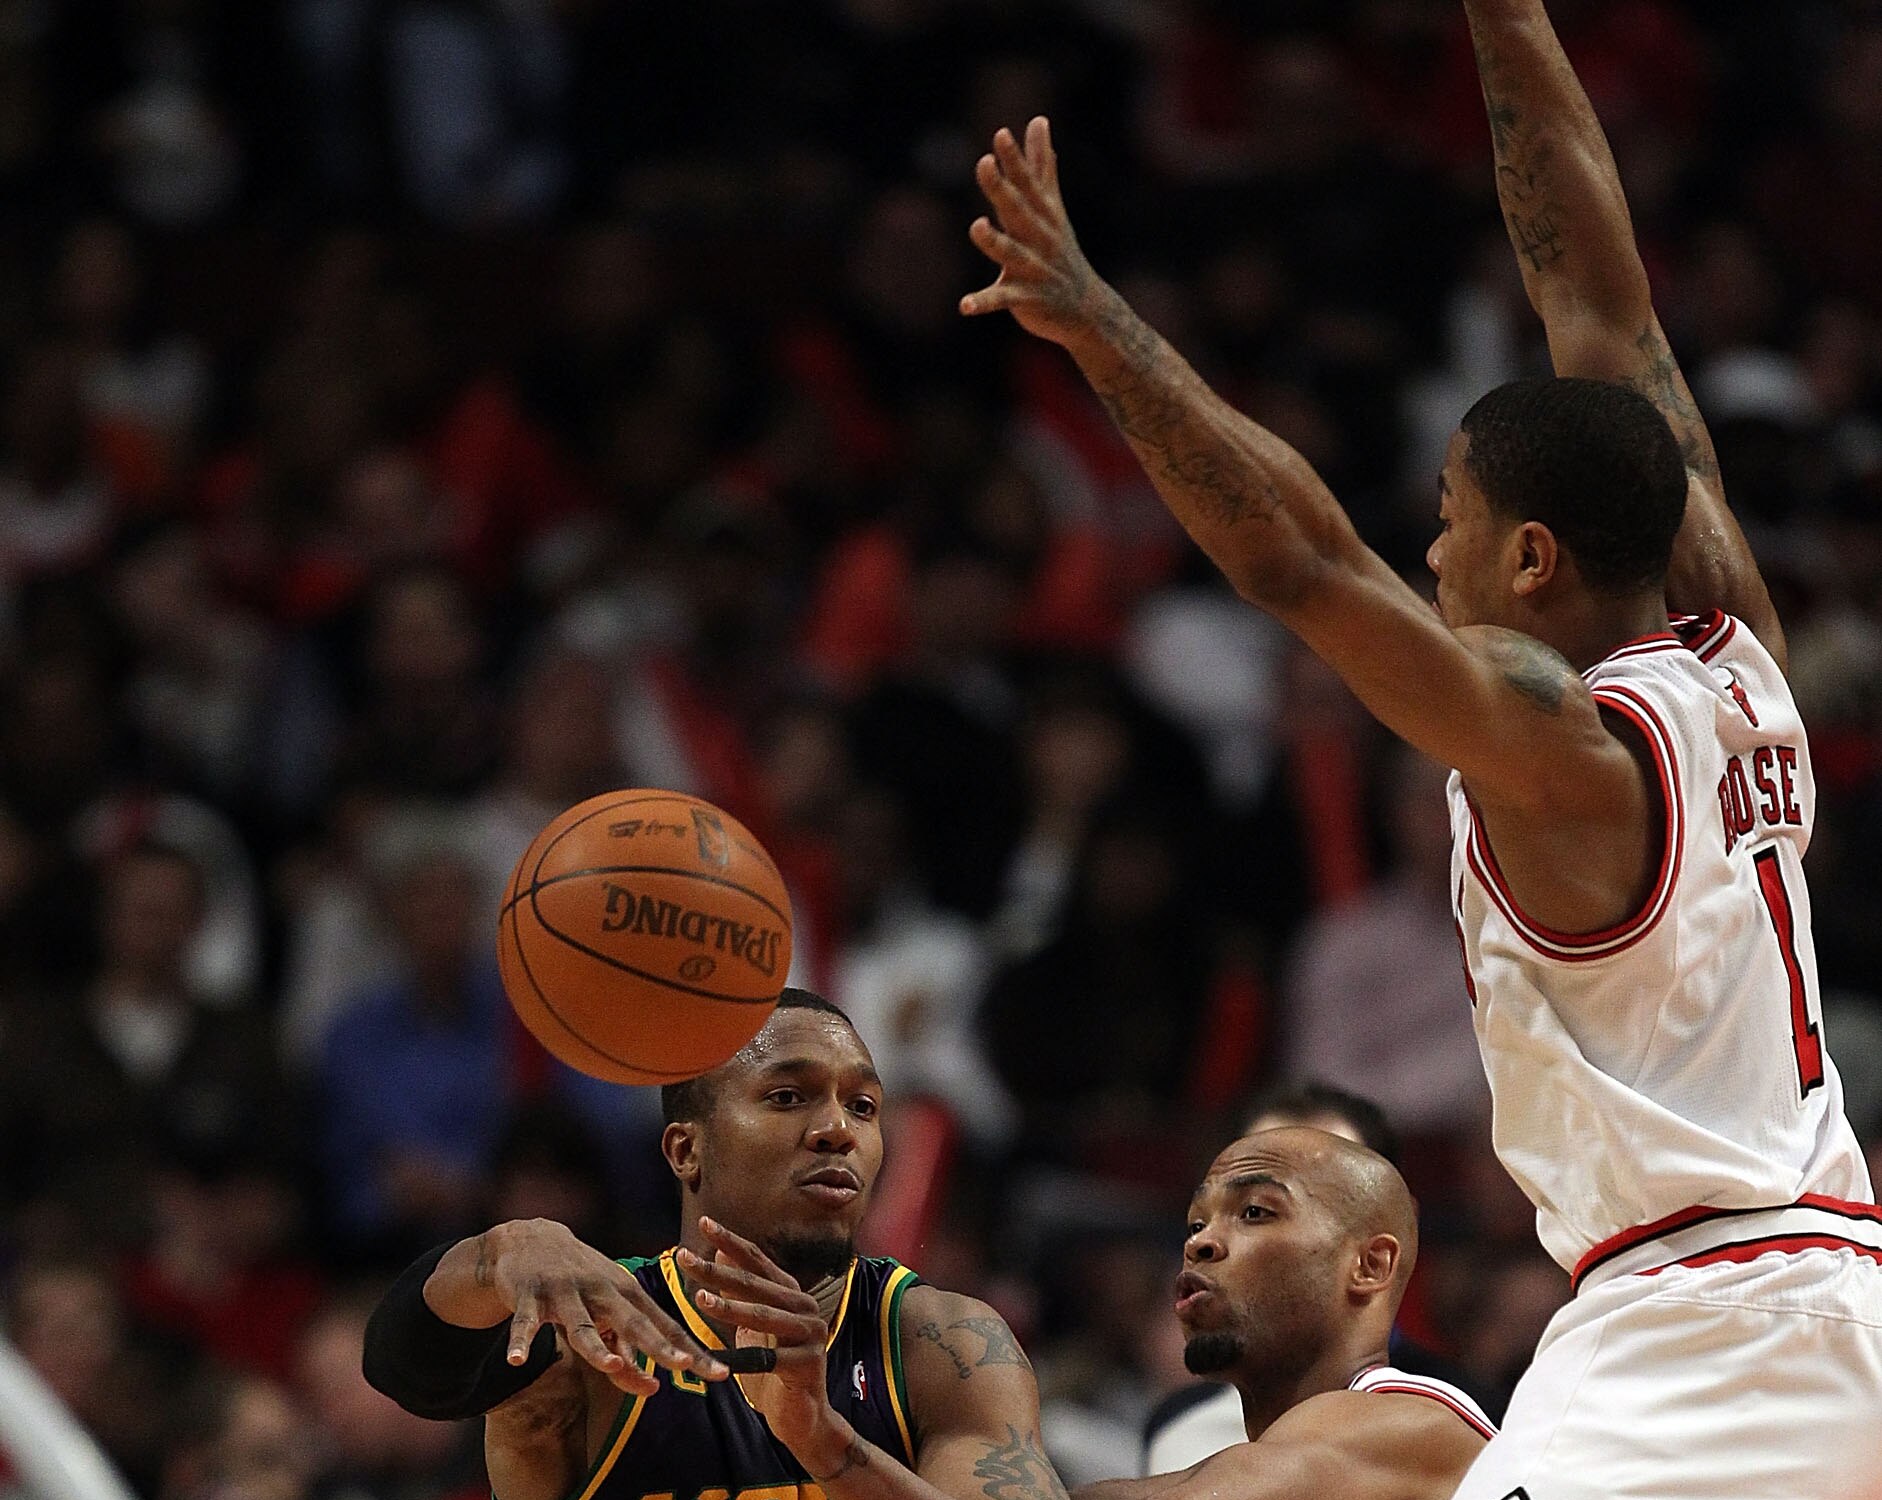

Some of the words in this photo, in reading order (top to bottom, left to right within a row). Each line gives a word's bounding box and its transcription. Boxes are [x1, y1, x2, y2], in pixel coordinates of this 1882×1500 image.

[1717, 745, 1803, 857] ROSE
[602, 879, 782, 978] SPALDING
[1752, 844, 1825, 1101] 1
